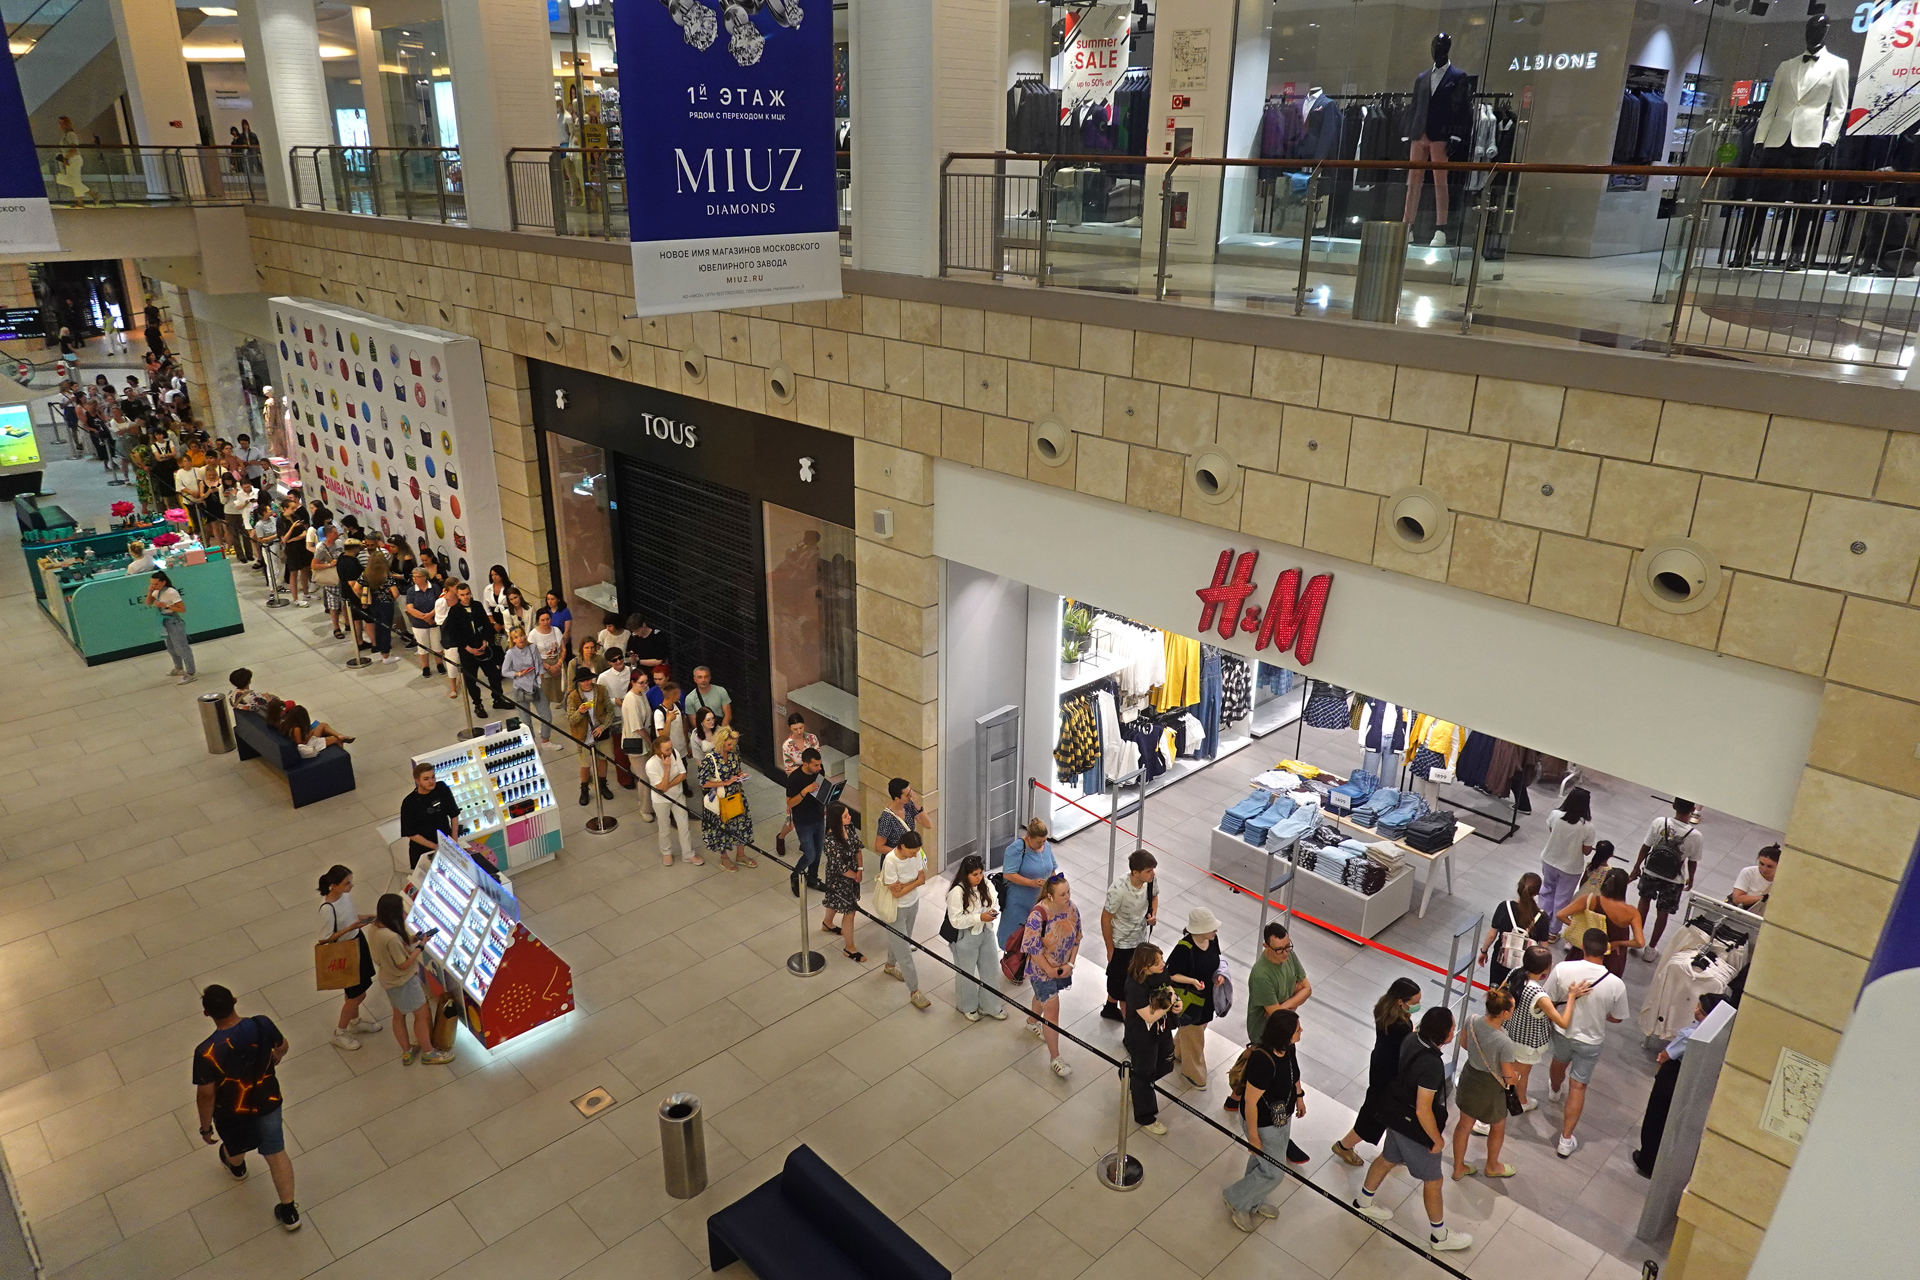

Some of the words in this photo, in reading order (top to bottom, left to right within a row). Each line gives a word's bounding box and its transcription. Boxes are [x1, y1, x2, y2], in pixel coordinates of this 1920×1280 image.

[1891, 20, 1920, 48] S
[1076, 38, 1118, 49] summer
[1075, 50, 1118, 69] SALE
[1508, 52, 1598, 71] ALBIONE
[1892, 68, 1908, 78] up
[1091, 79, 1104, 87] 50%
[719, 88, 786, 107] ЭТАЖ
[689, 111, 714, 119] РЯДОМ
[722, 112, 764, 120] ПЕРЕХОДОМ
[674, 148, 803, 193] MIUZ
[706, 202, 776, 216] DIAMONDS
[659, 249, 689, 259] НОВОЕ
[691, 248, 710, 258] ИМЯ
[712, 246, 761, 257] МАГАЗИНОВ
[762, 242, 820, 254] МОСКОВСКОГО
[698, 261, 755, 272] ЮВЕЛИРНОГО
[756, 258, 788, 268] ЗАВОДА
[726, 274, 764, 284] MIUZ.RU
[641, 413, 697, 448] TOUS
[324, 475, 347, 498] BIMBA
[346, 486, 352, 501] Y
[352, 490, 373, 512] LOLA
[1196, 547, 1335, 667] H&M
